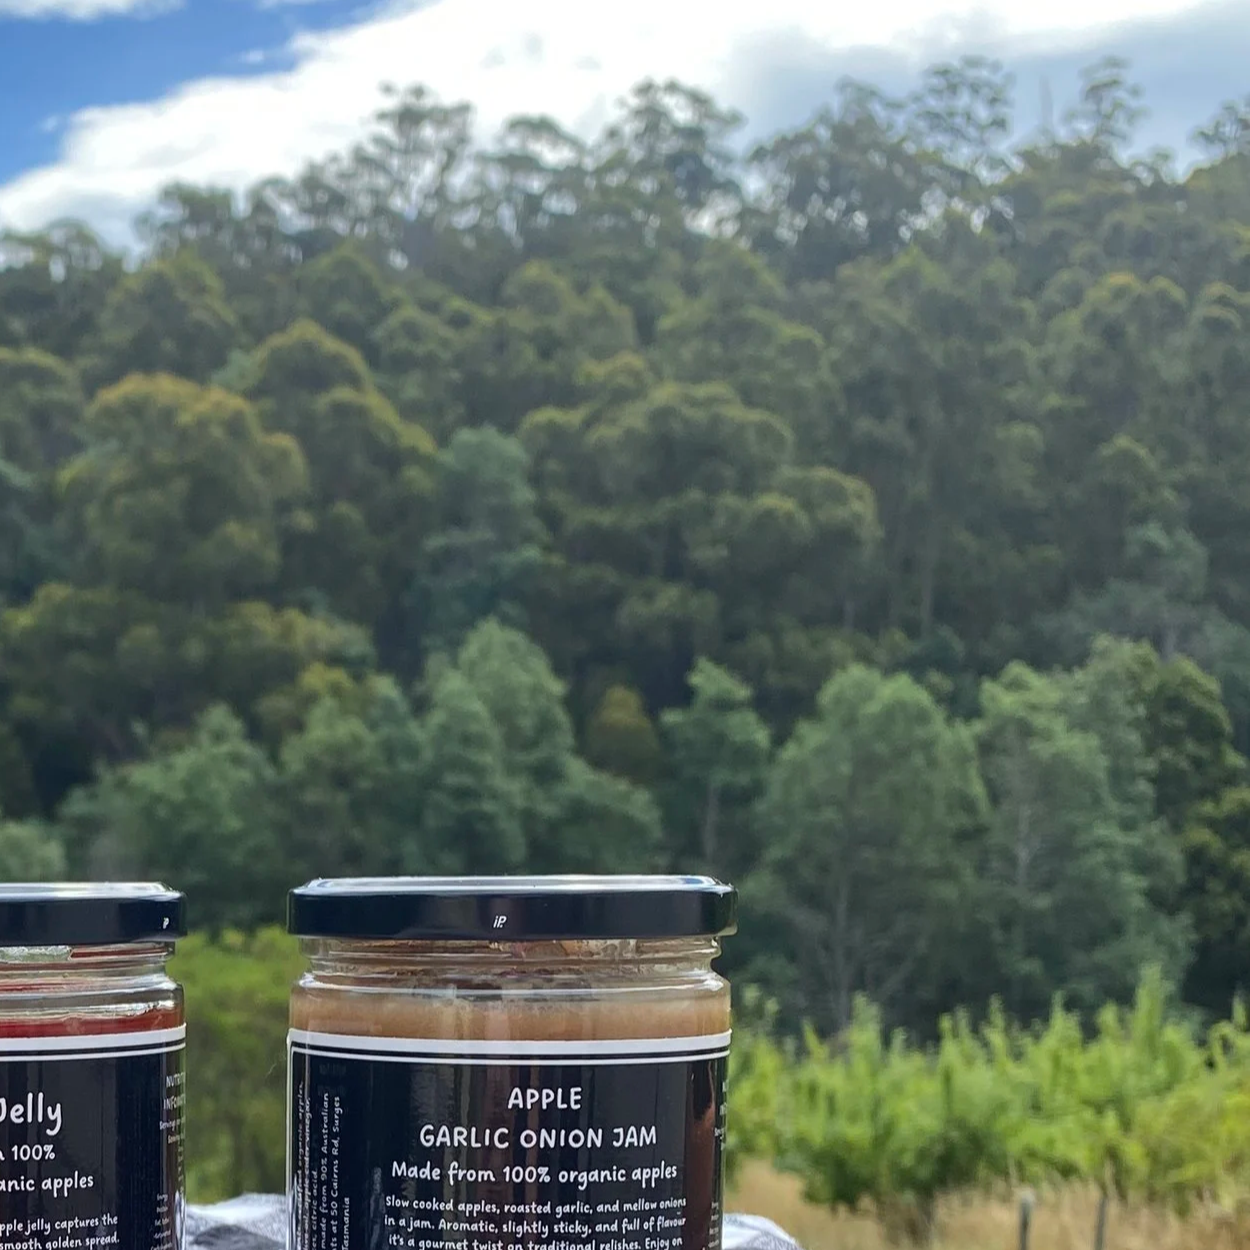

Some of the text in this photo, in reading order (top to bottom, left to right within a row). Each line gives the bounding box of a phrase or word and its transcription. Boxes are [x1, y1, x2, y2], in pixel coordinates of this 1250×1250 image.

[507, 1087, 582, 1110] APPLE
[419, 1124, 657, 1149] GARLIC ONION JAM
[11, 1144, 56, 1161] 100%
[41, 1170, 94, 1198] apples
[392, 1160, 678, 1191] Made from 100% organic apples
[385, 1194, 687, 1218] Slow cooked apples, roasted garlic, and mellow onions
[25, 1218, 51, 1236] jelly
[54, 1216, 99, 1234] captures
[101, 1212, 118, 1226] the
[384, 1214, 687, 1238] in a jam. Aromatic, slightly sticky, and full of flavour
[85, 1231, 120, 1250] spread.
[389, 1234, 404, 1246] it's
[407, 1238, 415, 1247] a
[672, 1236, 683, 1247] on
